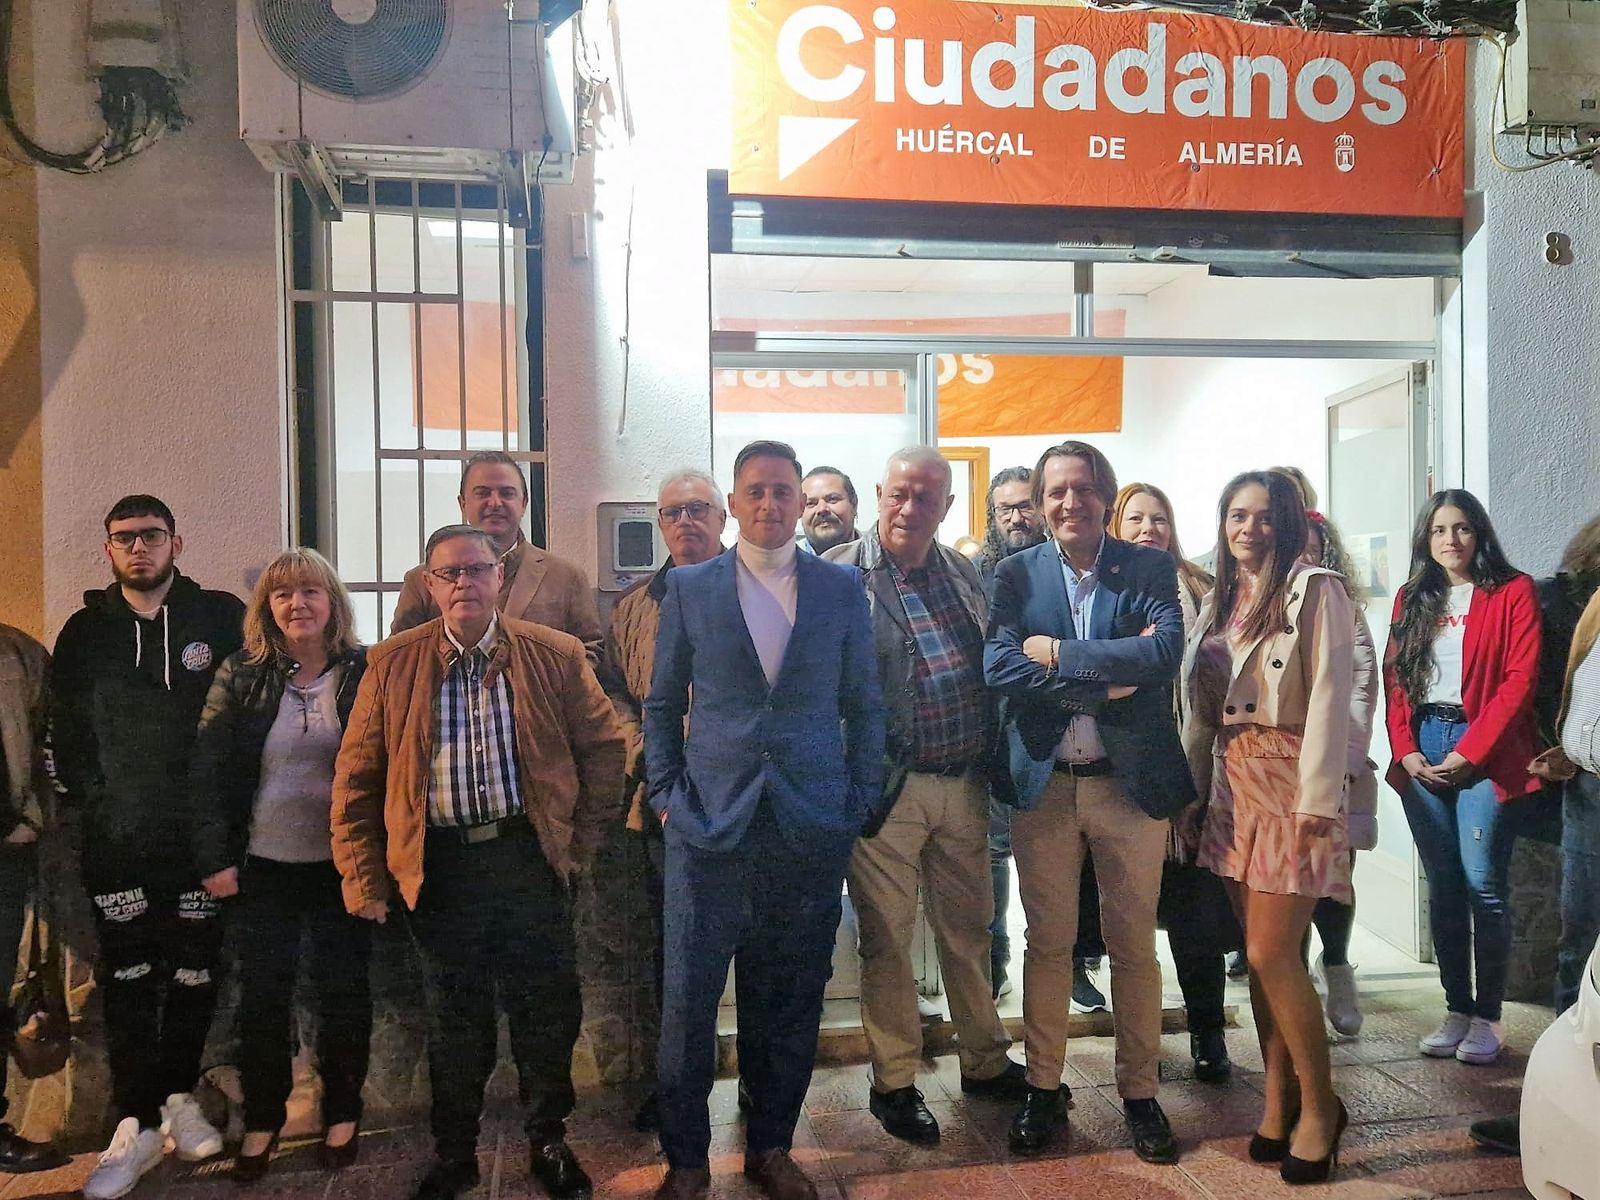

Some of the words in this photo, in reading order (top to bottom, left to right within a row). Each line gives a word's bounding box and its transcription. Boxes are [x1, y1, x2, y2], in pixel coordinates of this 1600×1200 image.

[777, 5, 1407, 125] Ciudadanos
[896, 123, 1034, 156] HUÉRCAL
[1088, 135, 1127, 160] DE
[1178, 137, 1303, 166] ALMERÍA
[1546, 231, 1571, 266] 8
